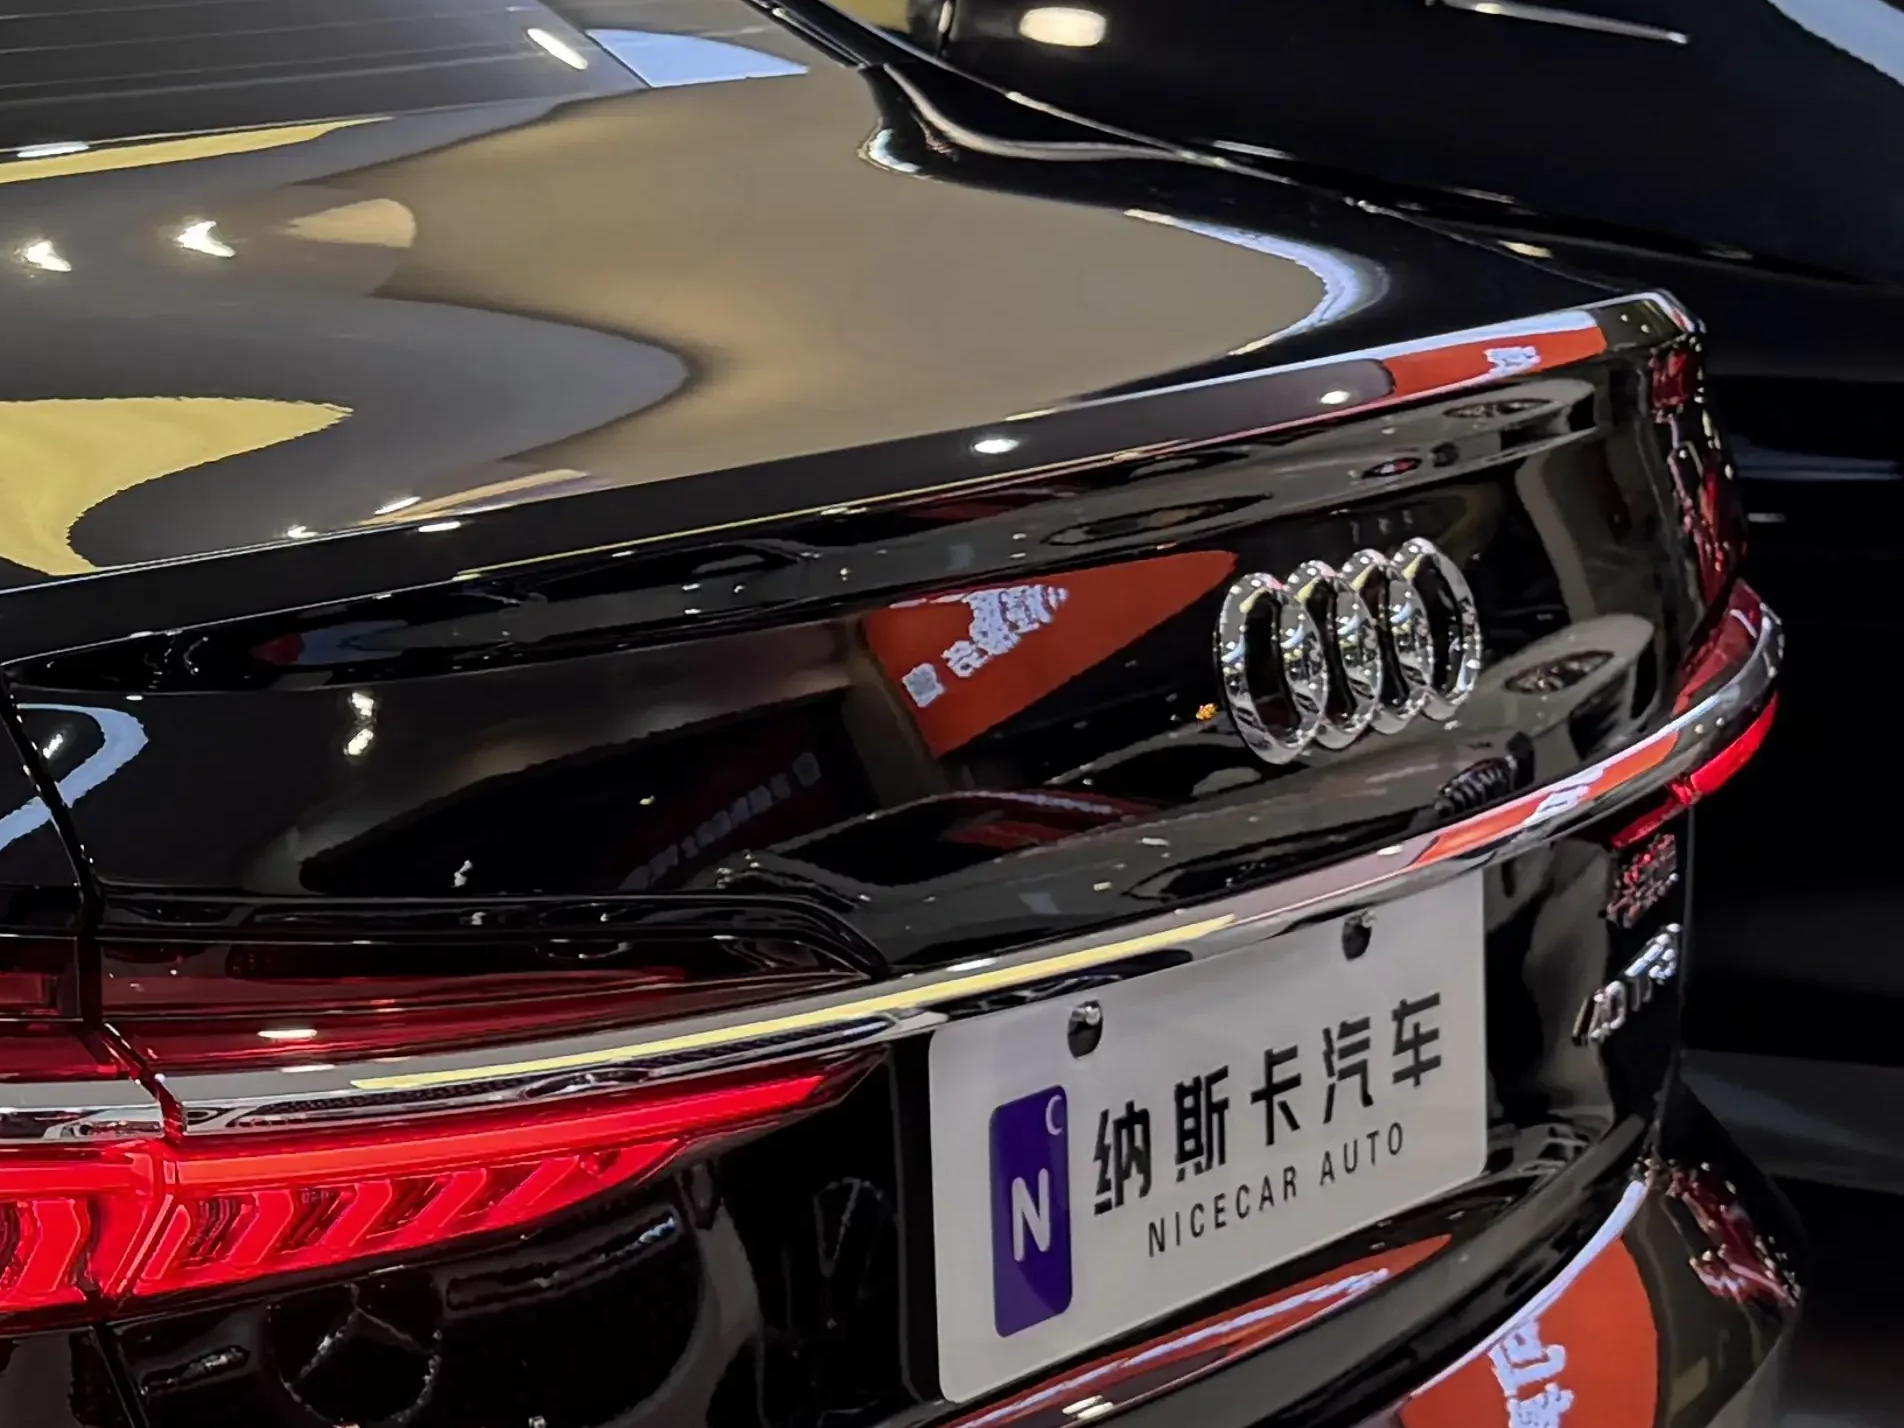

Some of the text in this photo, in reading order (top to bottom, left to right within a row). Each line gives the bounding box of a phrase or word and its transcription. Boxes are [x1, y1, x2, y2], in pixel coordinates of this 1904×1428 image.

[1092, 991, 1443, 1217] 纳斯卡汽车
[1147, 1121, 1405, 1257] NICECAR AUTO
